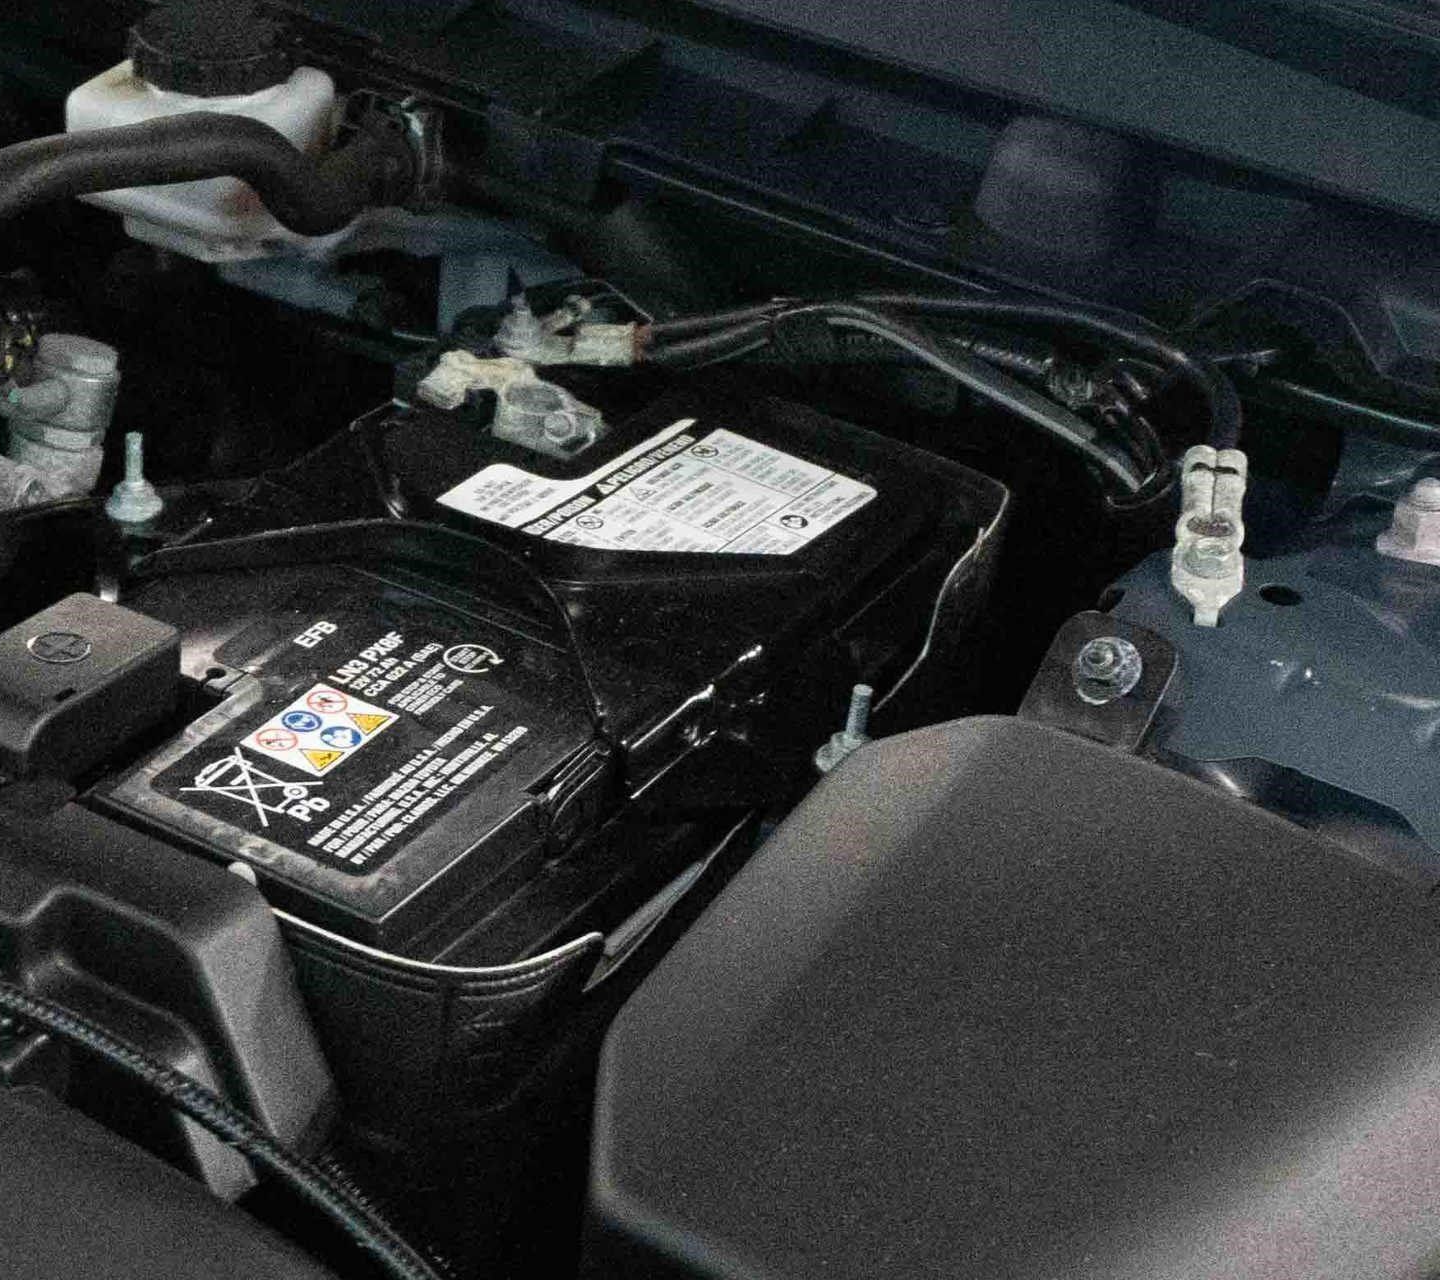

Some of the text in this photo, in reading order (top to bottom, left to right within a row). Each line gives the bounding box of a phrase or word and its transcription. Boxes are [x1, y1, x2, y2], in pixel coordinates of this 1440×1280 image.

[293, 621, 338, 648] EFB
[329, 631, 404, 683] LN3 PX8F
[361, 679, 392, 697] CCA
[401, 660, 417, 668] A
[286, 797, 330, 822] Pb
